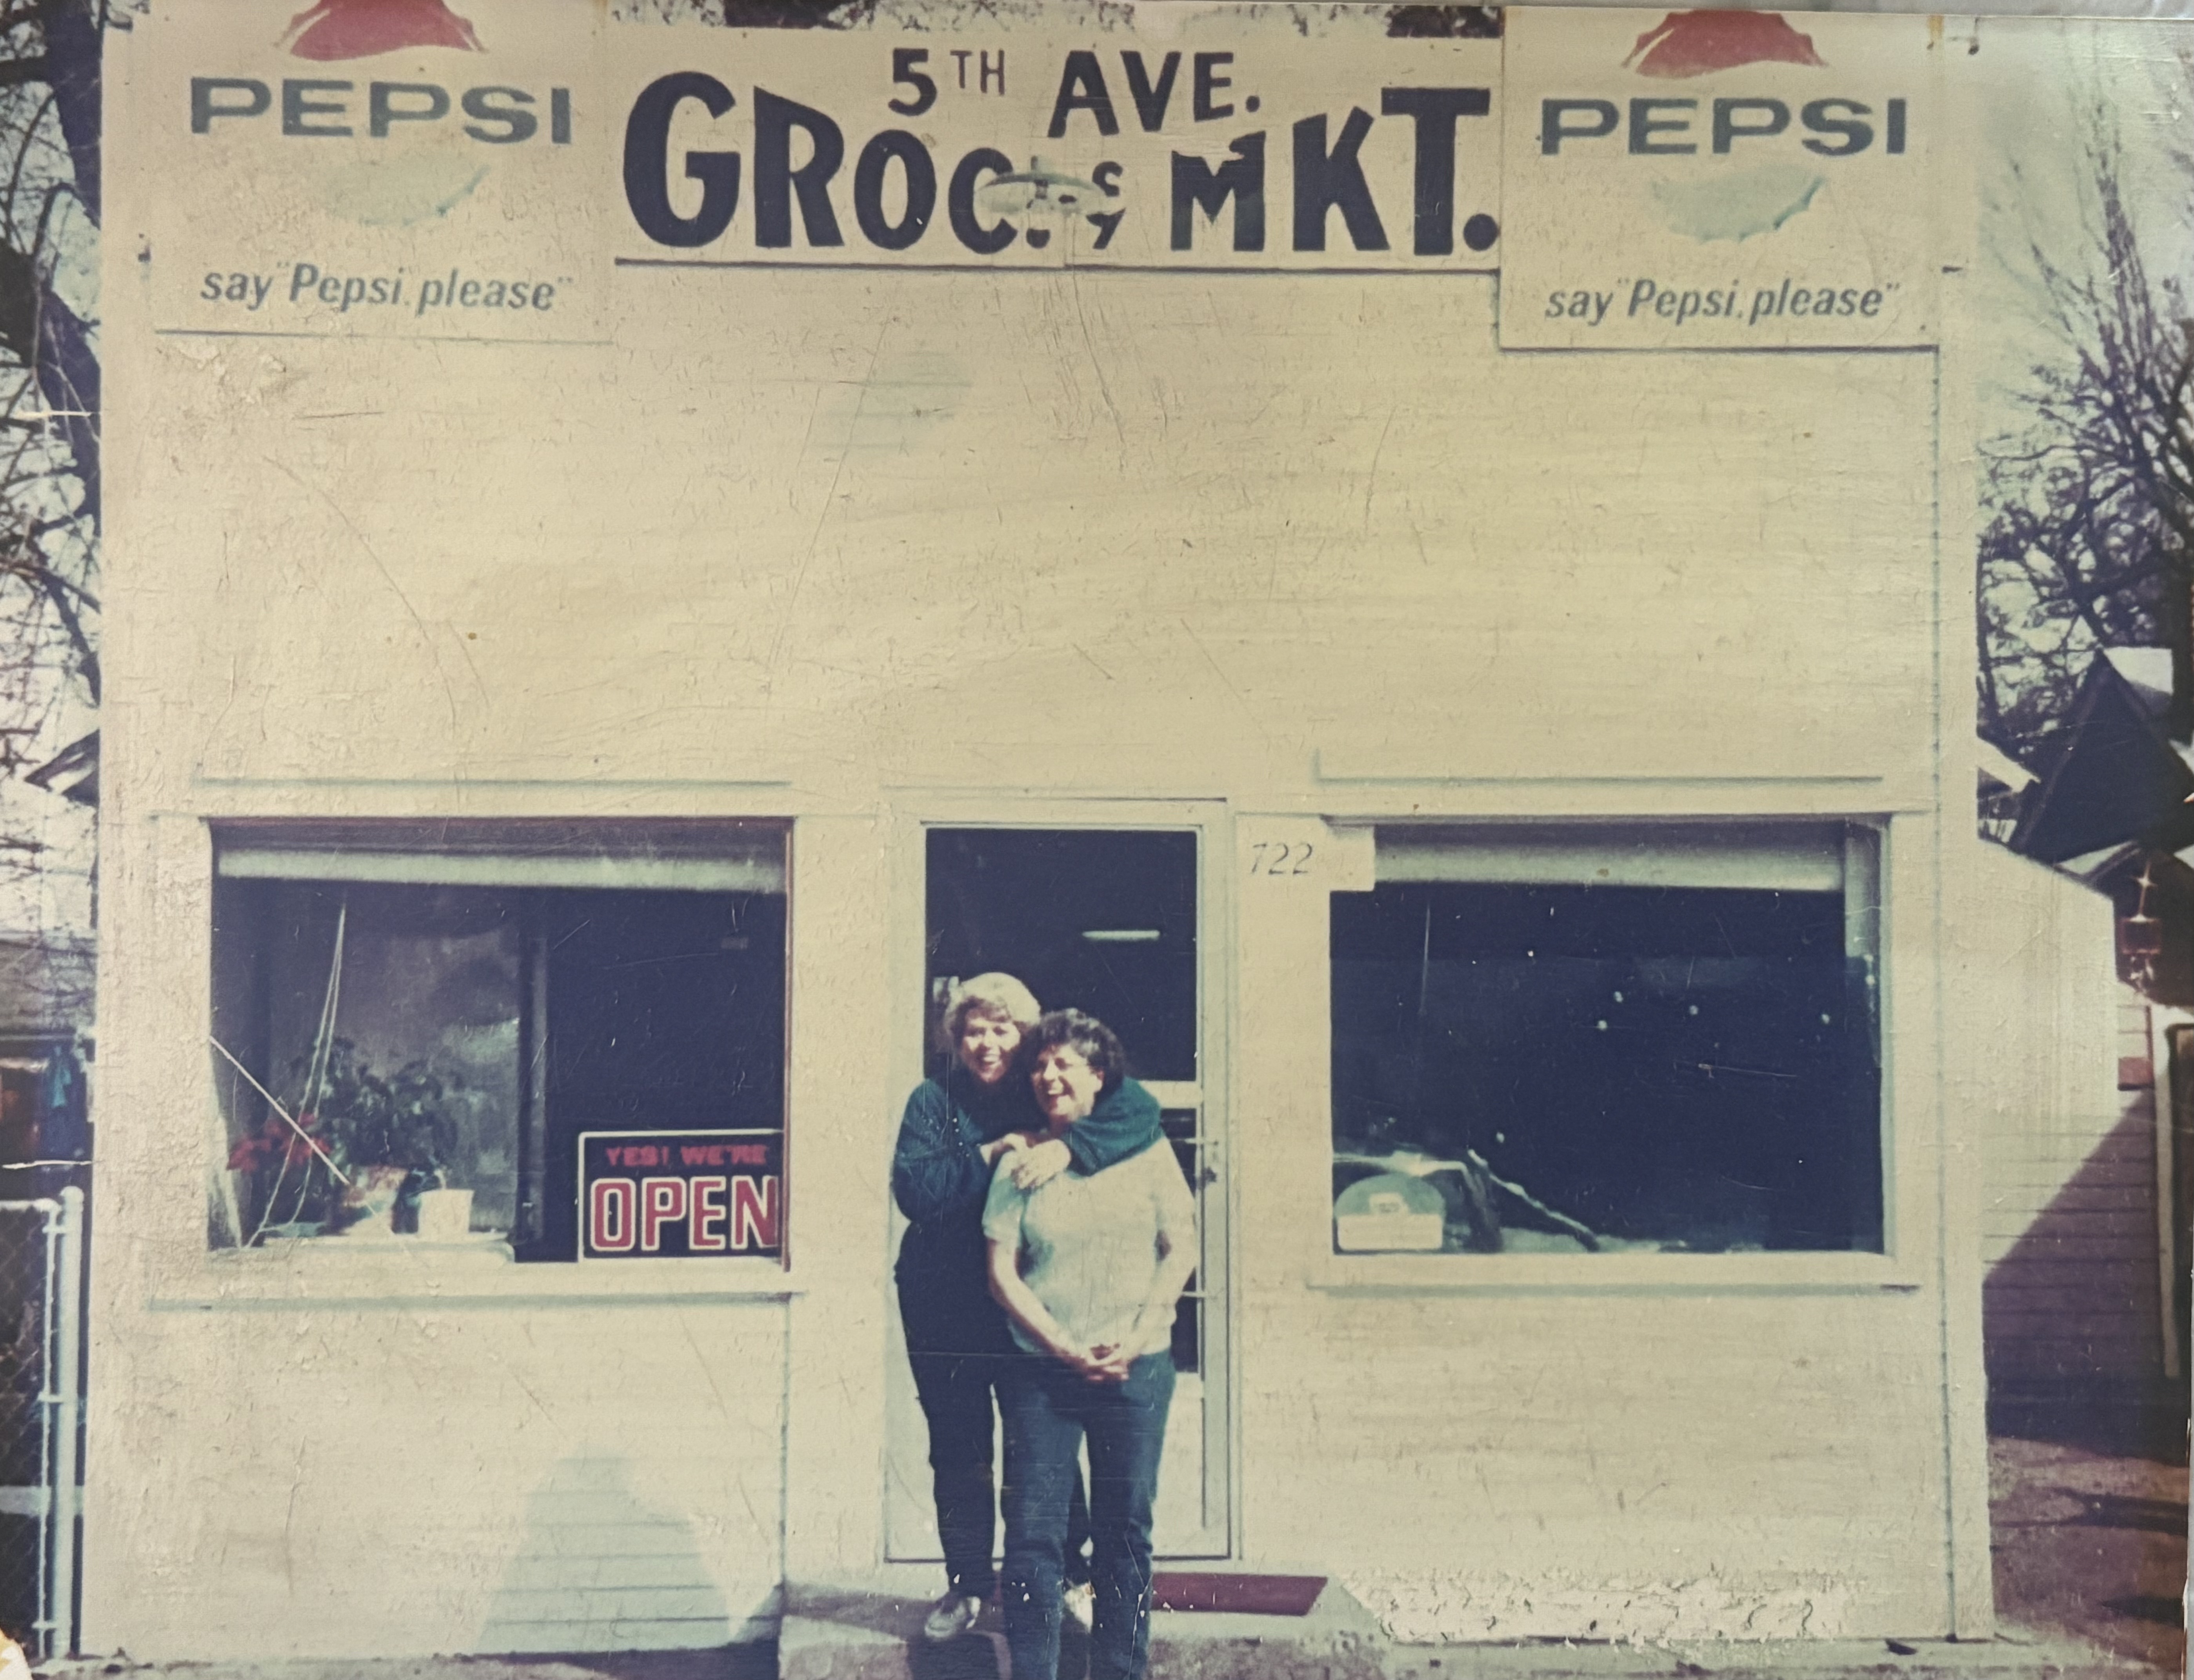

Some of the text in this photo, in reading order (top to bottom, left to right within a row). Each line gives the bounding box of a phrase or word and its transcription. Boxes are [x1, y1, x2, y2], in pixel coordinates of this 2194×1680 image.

[191, 77, 572, 145] PEPSI
[888, 47, 1260, 138] 5TH AVE.
[1541, 98, 1907, 156] PEPSI
[1170, 87, 1499, 256] MKT.
[200, 271, 274, 311] say
[1544, 290, 1614, 326] say
[1251, 842, 1313, 875] 722
[591, 1175, 779, 1251] OPEN
